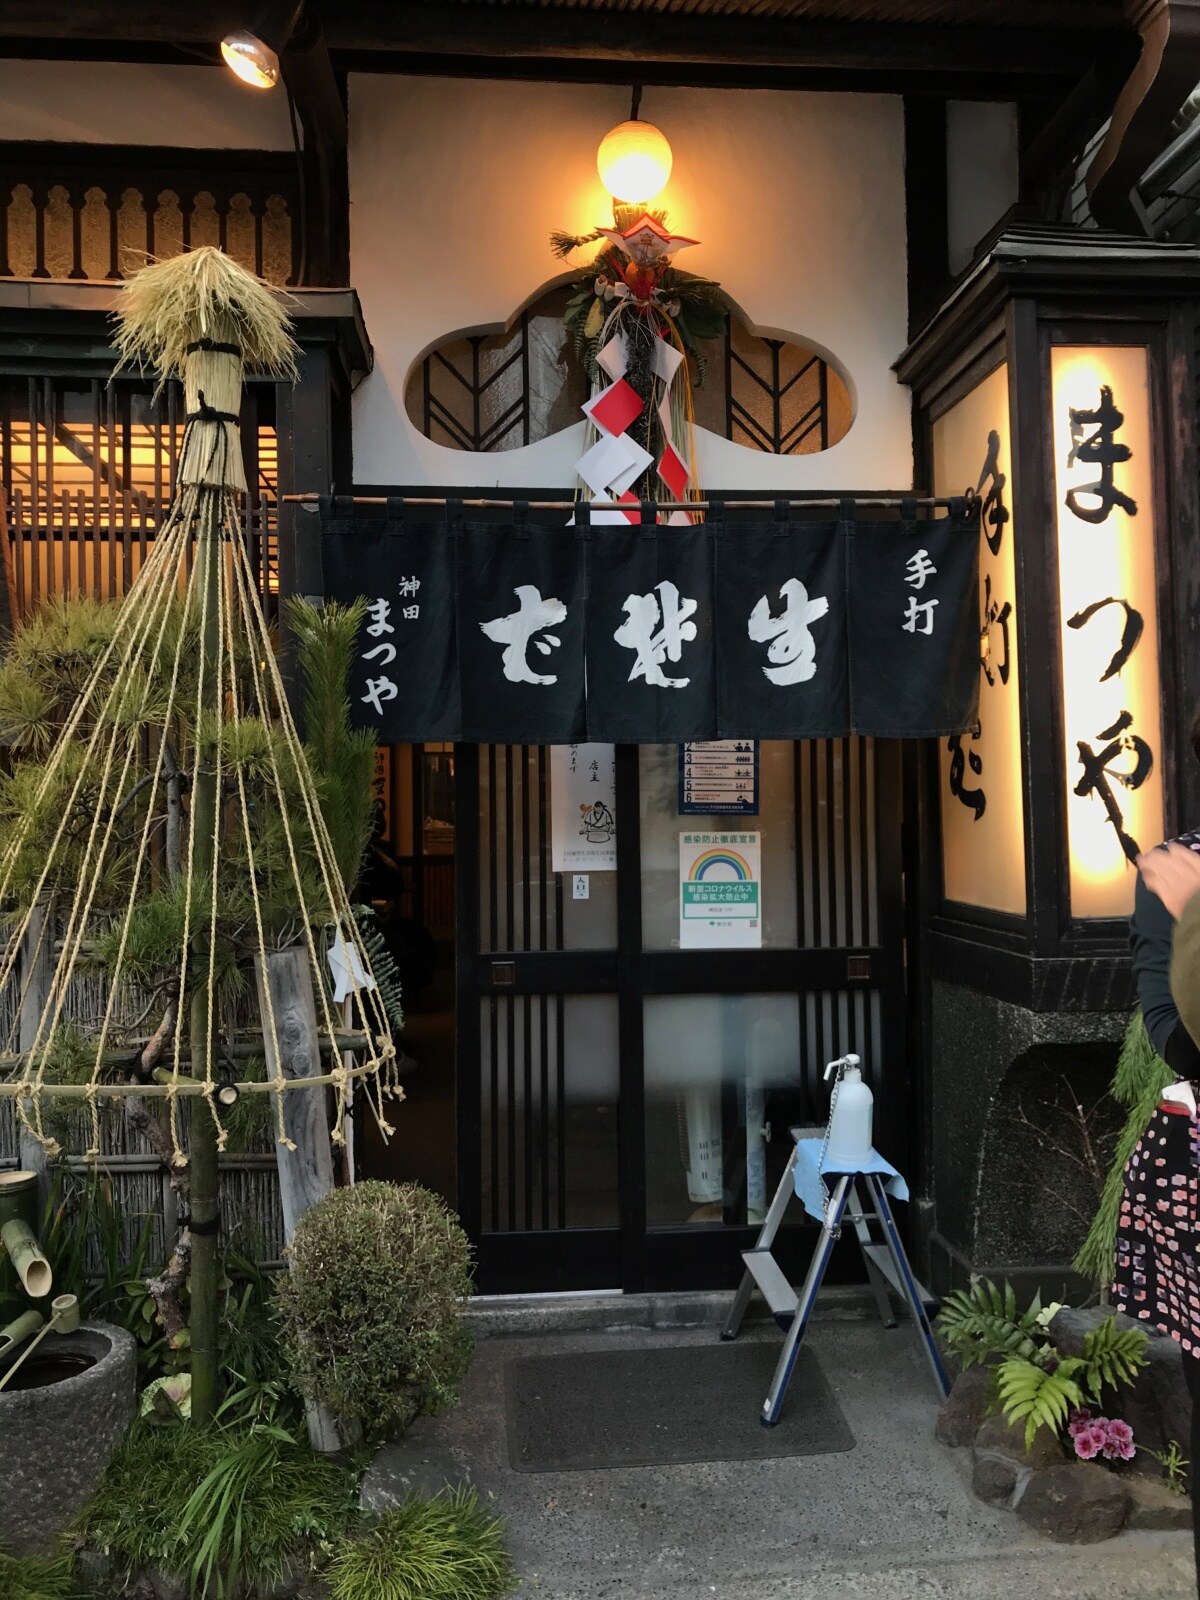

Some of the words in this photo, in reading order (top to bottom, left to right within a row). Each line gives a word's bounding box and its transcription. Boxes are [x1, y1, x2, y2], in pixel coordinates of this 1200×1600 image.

[399, 575, 421, 620] 神田
[902, 549, 940, 636] 手打
[1064, 384, 1154, 871] まつや
[360, 597, 399, 716] まつや
[685, 753, 693, 764] 3
[588, 759, 601, 783] 店主
[685, 768, 693, 779] 4
[685, 780, 693, 791] 5
[685, 792, 693, 803] 6
[683, 835, 757, 844] 感染防止徹底宣言
[687, 884, 753, 893] 新型コロナウイルス
[692, 892, 750, 901] 感染拡大防止中
